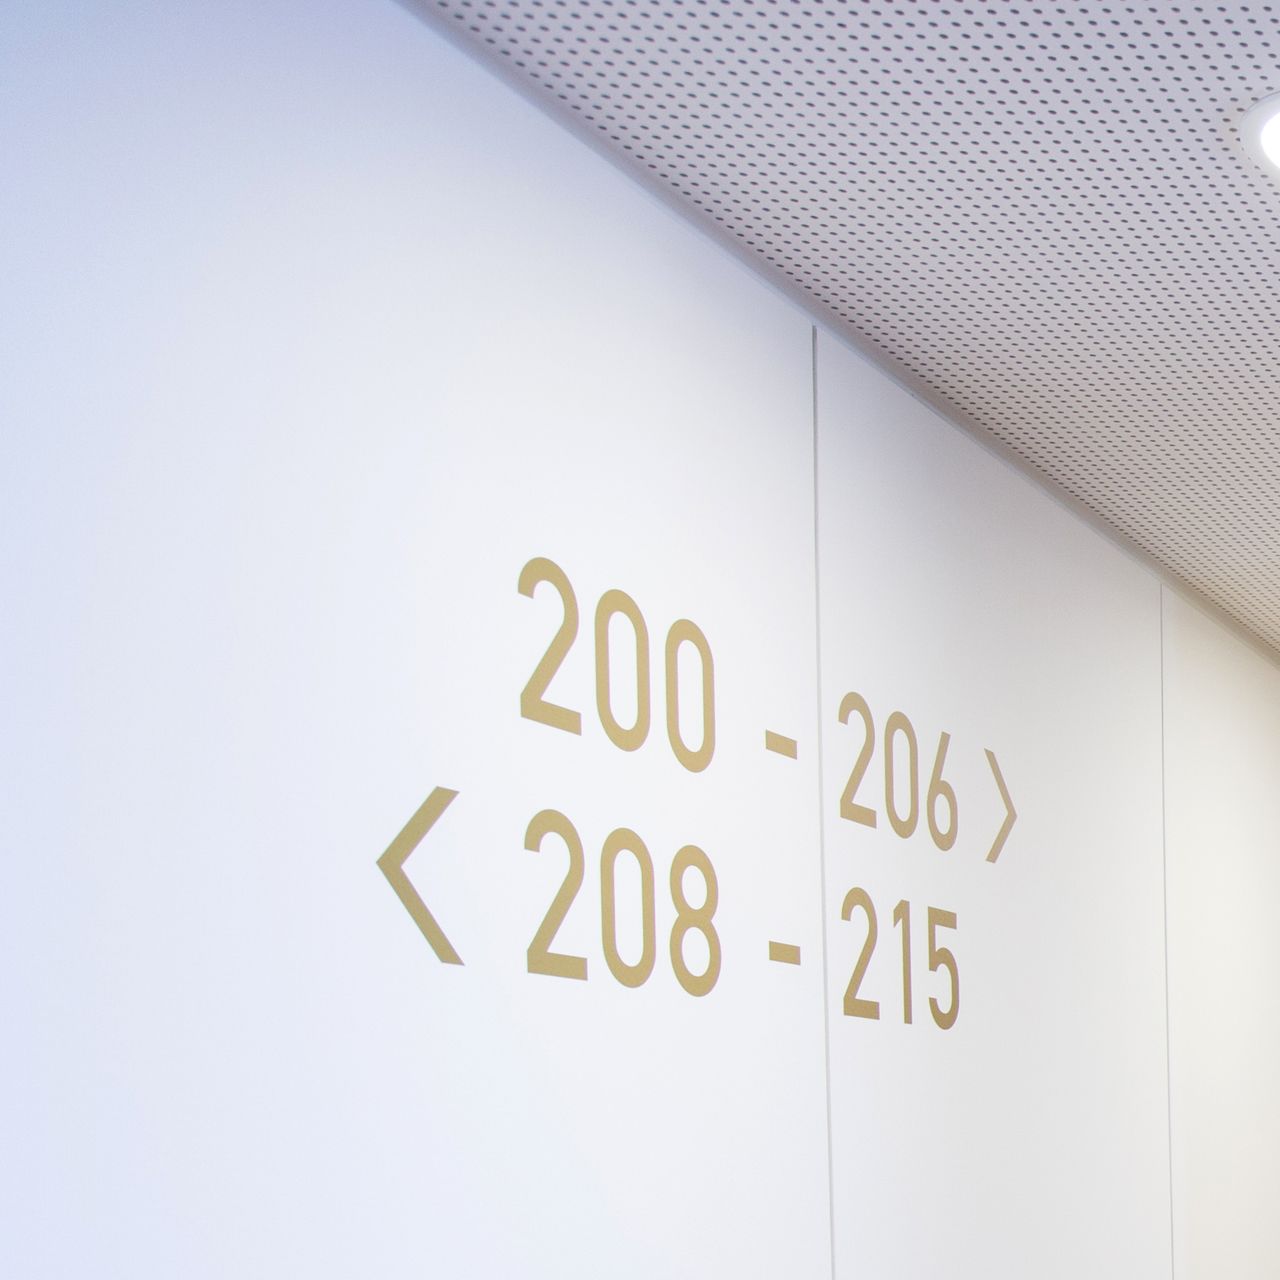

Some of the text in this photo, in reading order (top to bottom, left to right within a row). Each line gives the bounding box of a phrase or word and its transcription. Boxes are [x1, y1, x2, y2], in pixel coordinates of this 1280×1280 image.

[518, 556, 716, 774] 200
[837, 691, 958, 852] 206
[523, 808, 721, 998] 208
[840, 886, 959, 1031] 215
